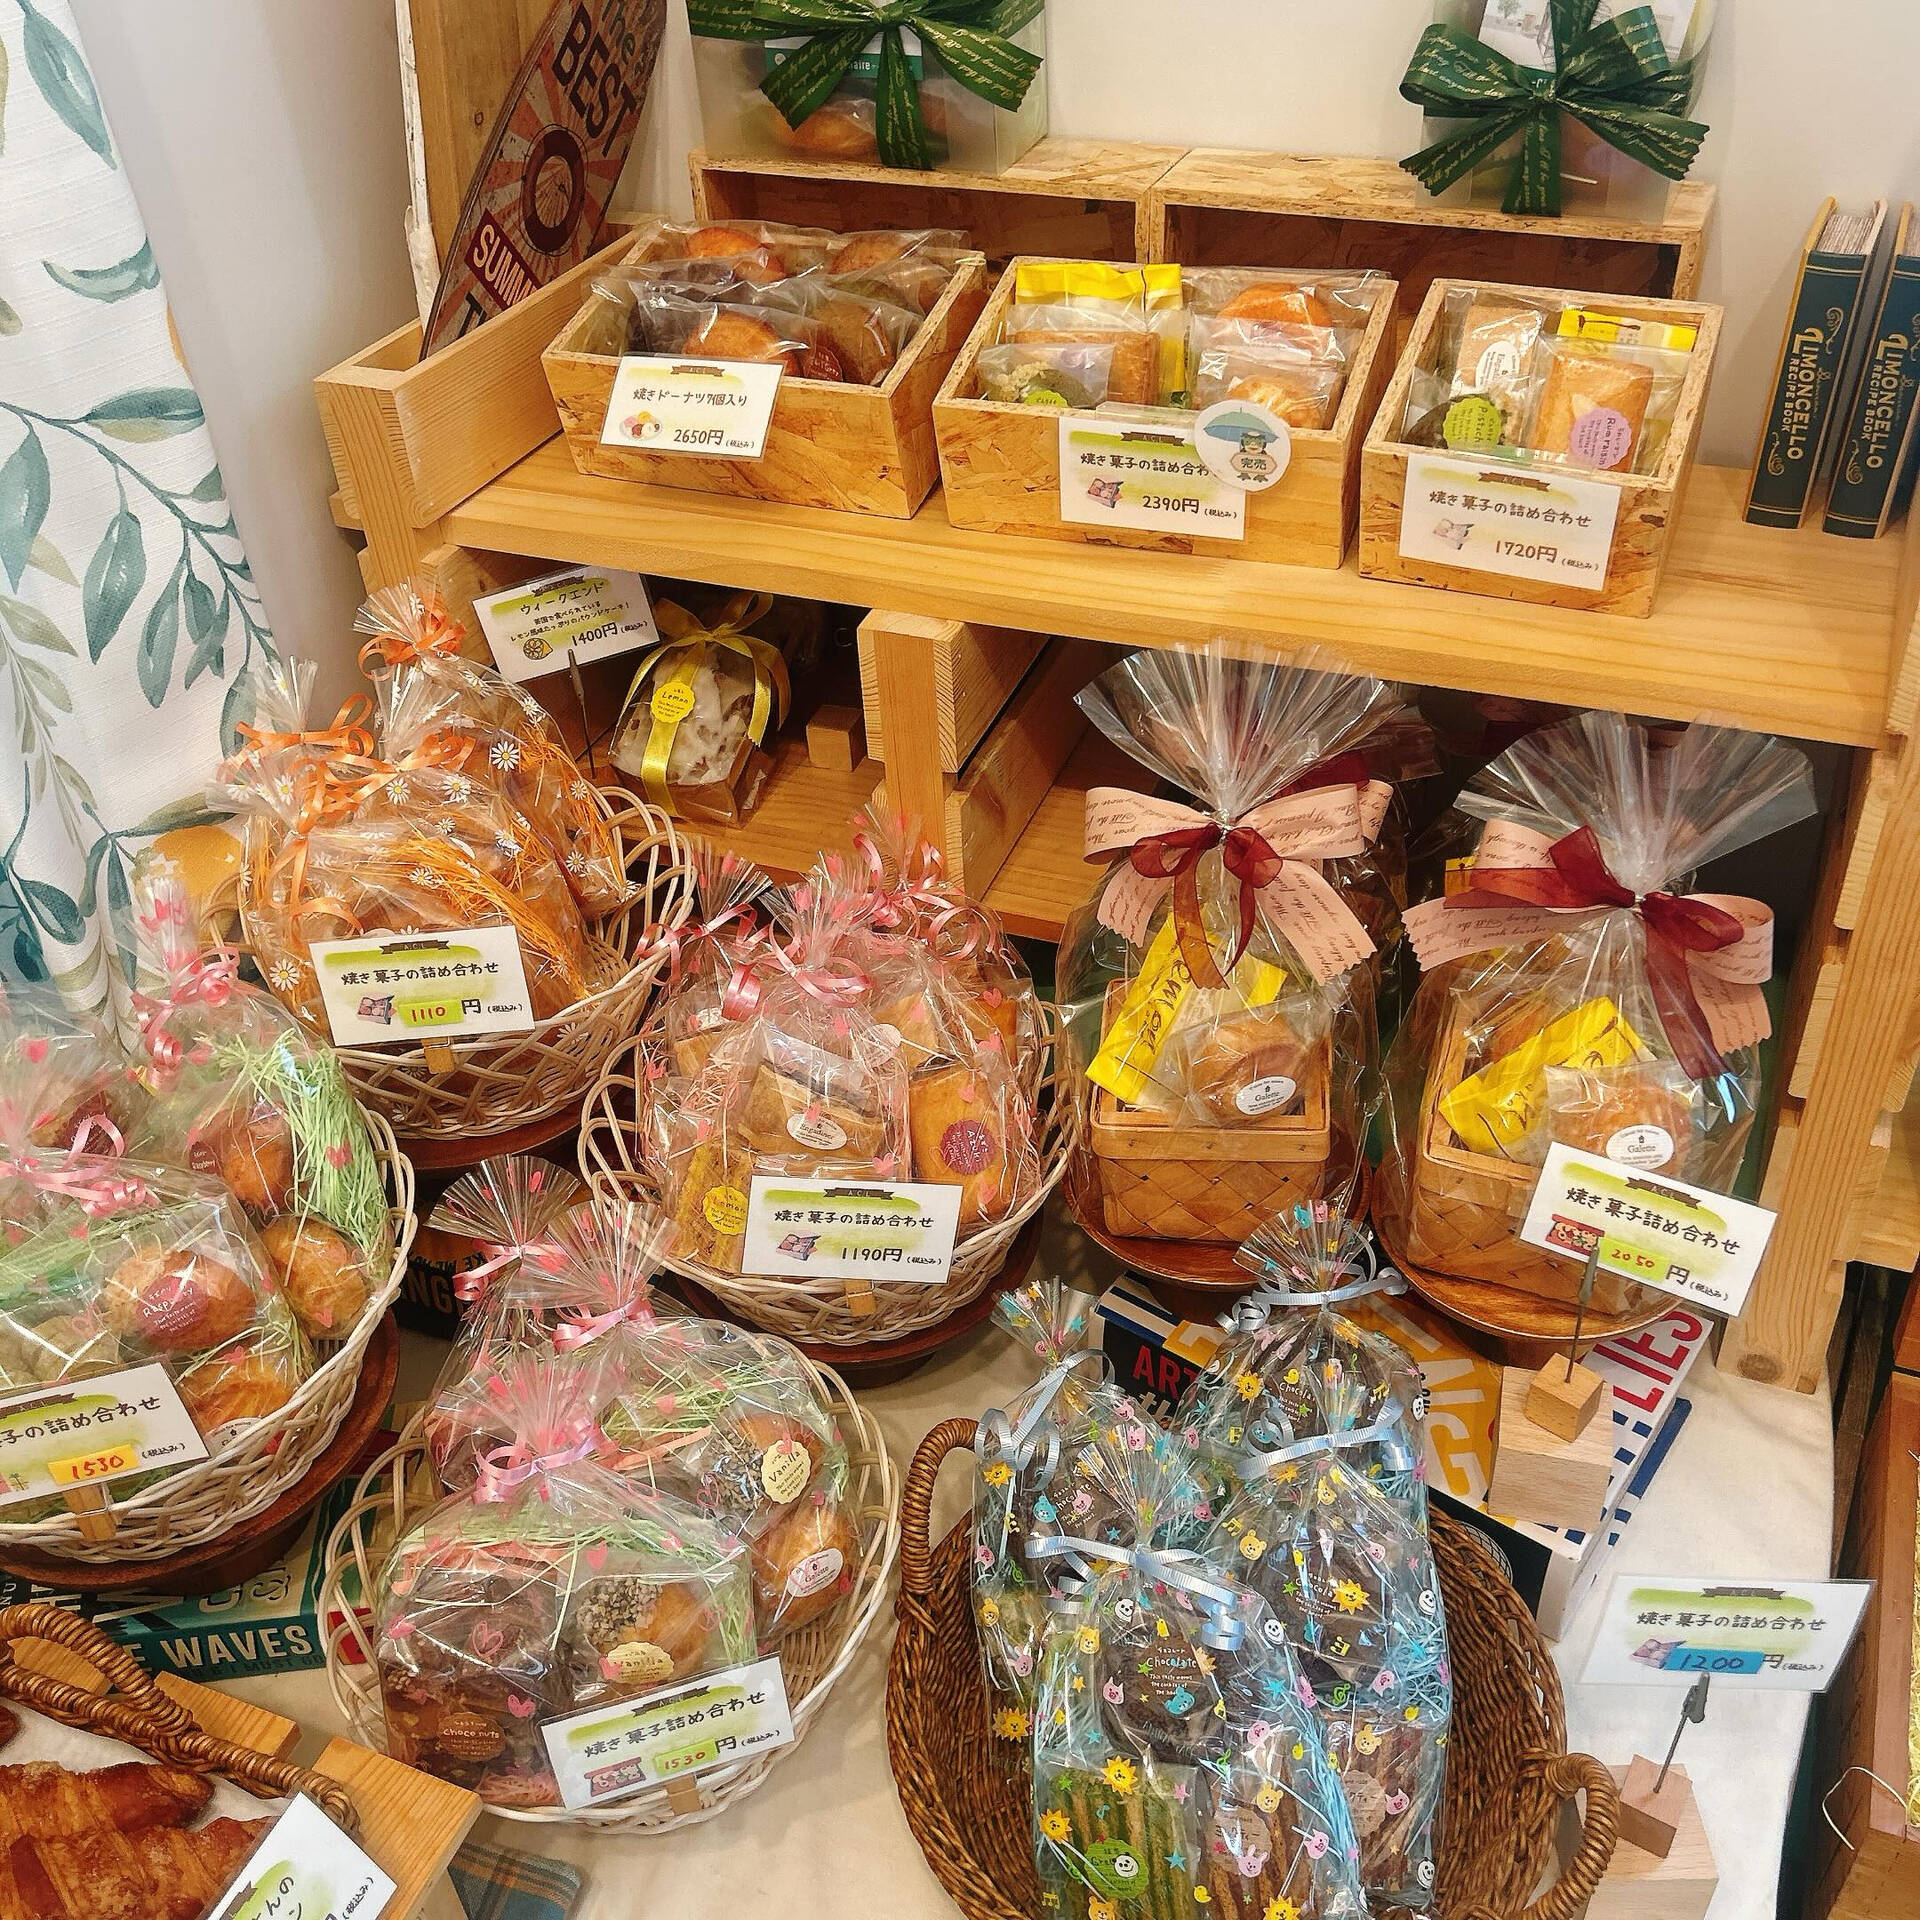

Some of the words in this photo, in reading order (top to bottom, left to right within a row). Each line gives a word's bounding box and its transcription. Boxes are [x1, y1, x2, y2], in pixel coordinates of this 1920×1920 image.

[551, 7, 637, 157] BEST
[1785, 358, 1800, 399] RECIPE
[1867, 364, 1883, 406] RECIPE
[633, 387, 748, 407] 焼きドーナツ7個入り
[1787, 327, 1824, 460] LIMONCELLO
[1866, 333, 1909, 469] LIMONCELLO
[1781, 402, 1794, 432] BOOK
[1862, 409, 1875, 440] BOOK
[674, 429, 724, 446] 2650円
[1080, 453, 1217, 477] 焼き菓子の詰め合わ
[1240, 456, 1267, 470] 完売
[1143, 495, 1199, 513] 2390円
[1429, 491, 1591, 528] 焼き菓子の詰め合わせ
[1495, 540, 1558, 564] 1720円
[520, 582, 604, 615] ウィークエンド
[572, 622, 618, 646] 1400円
[661, 693, 689, 704] Lemon
[341, 962, 499, 985] 焼き菓子の詰め合わせ
[461, 999, 481, 1015] 円
[774, 1209, 934, 1228] 焼き菓子の詰め合わせ
[1565, 1188, 1740, 1256] 焼き菓子詰め合わせ
[841, 1247, 902, 1263] 1190円
[1666, 1264, 1690, 1286] 円
[0, 1396, 161, 1448] 子の詰め合わせ
[72, 1455, 124, 1480] 1530
[769, 1451, 801, 1483] Vanilla
[1637, 1611, 1827, 1632] 焼き菓子の詰め合わせ
[160, 1625, 314, 1669] WAVES
[1680, 1655, 1744, 1670] 1200
[478, 1731, 500, 1739] nuts
[584, 1691, 766, 1758] 焼き菓子詰め合わせ
[664, 1751, 706, 1770] 1530
[716, 1735, 737, 1754] 円
